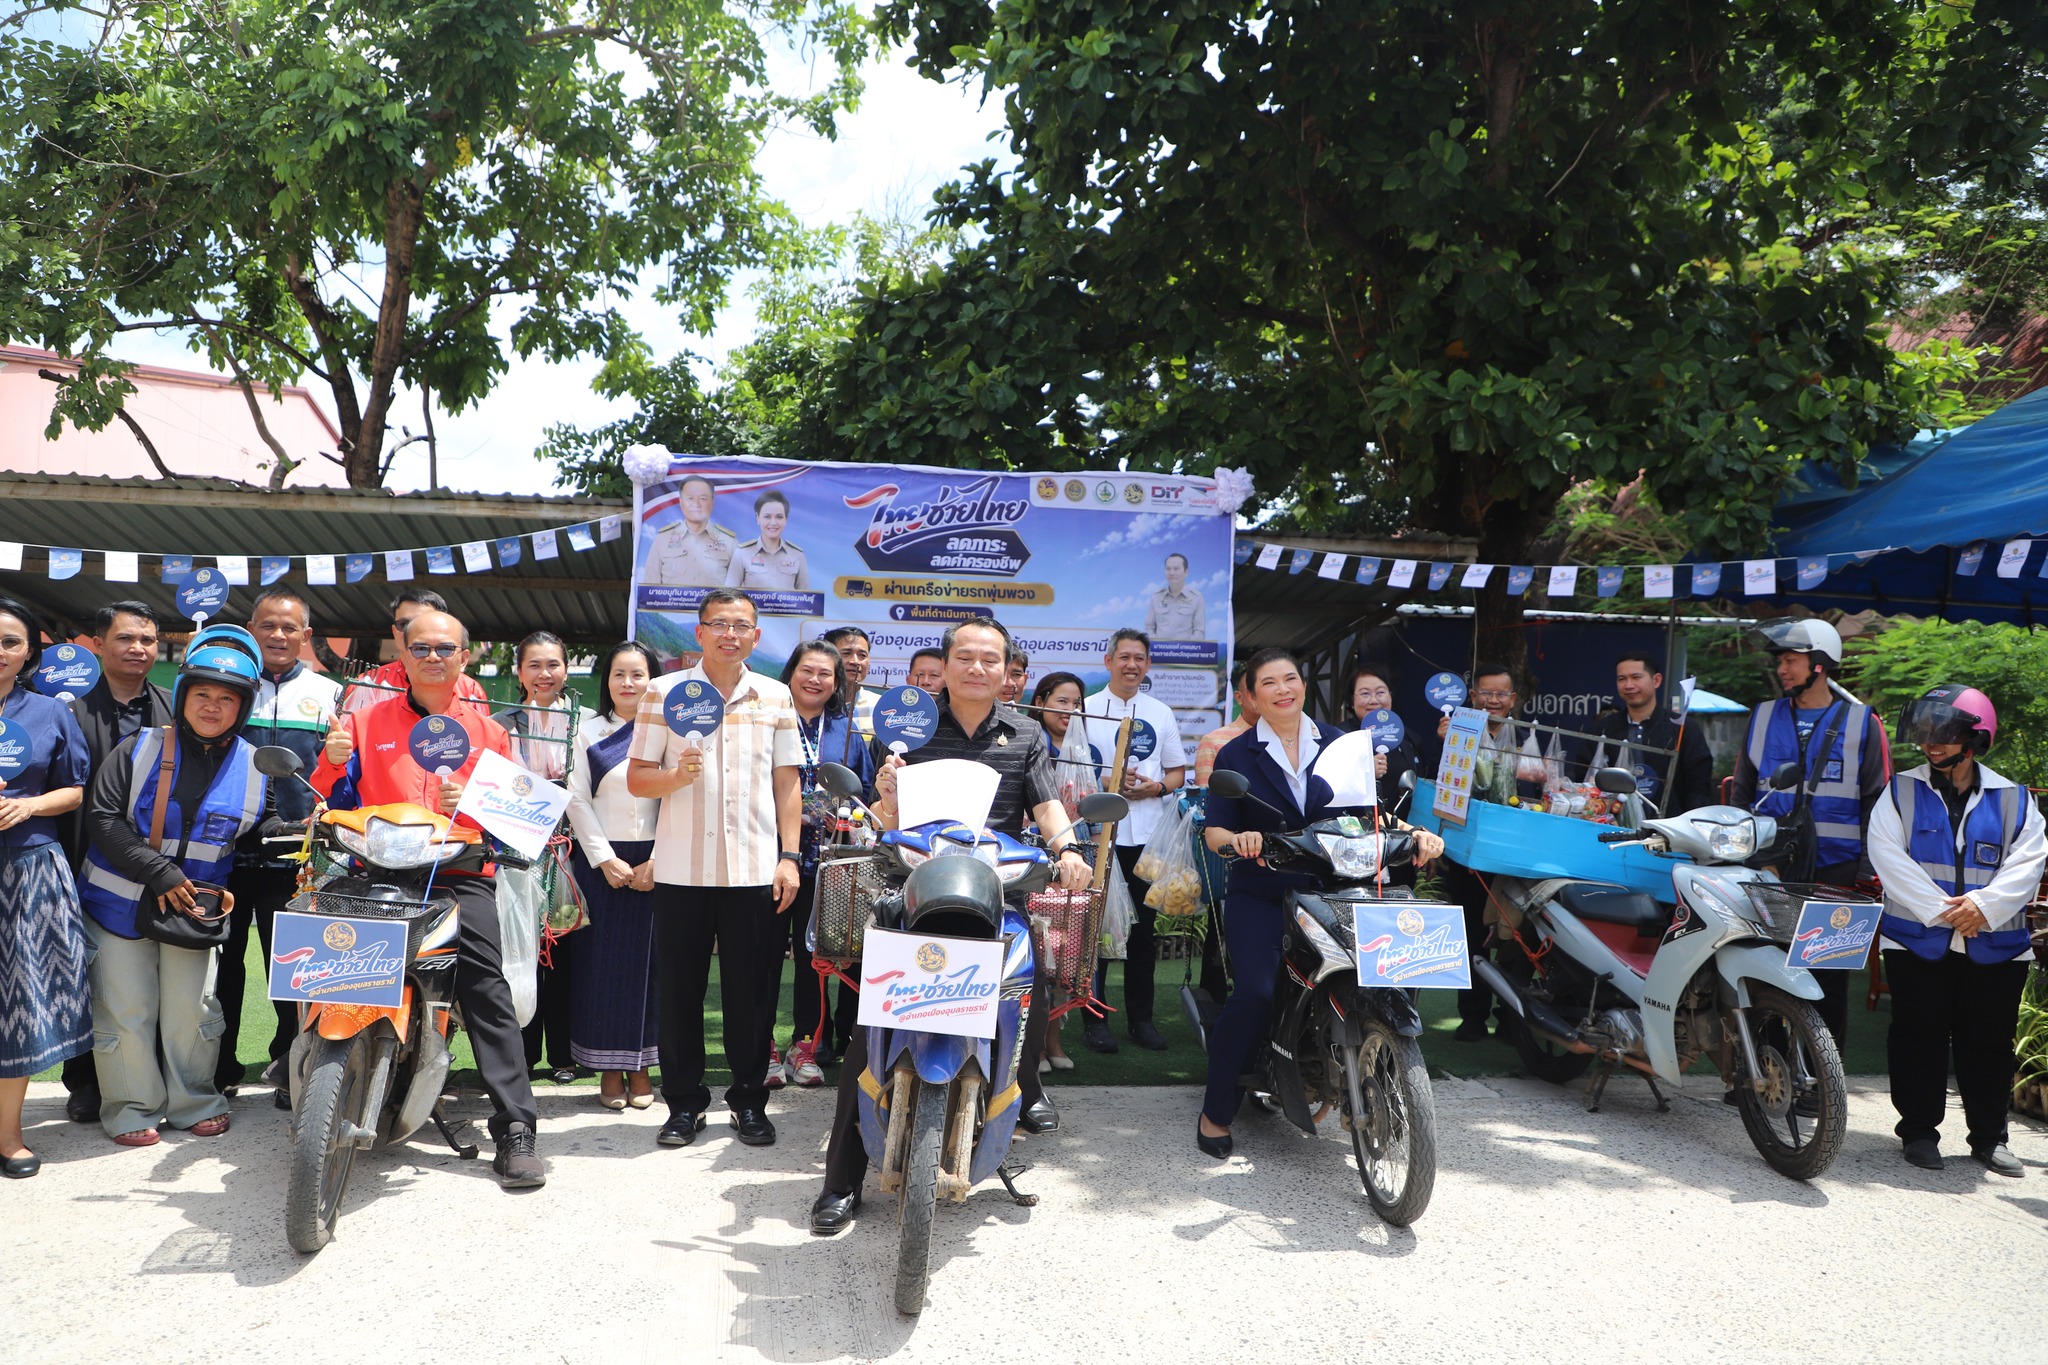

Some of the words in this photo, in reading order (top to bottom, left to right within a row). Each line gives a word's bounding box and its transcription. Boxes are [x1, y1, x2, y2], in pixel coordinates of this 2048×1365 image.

[844, 476, 1029, 549] ไทยช่วยไทย
[946, 537, 1008, 551] ลดภาระ
[930, 554, 1021, 570] ลดค่าครองชีพ
[884, 581, 1036, 602] ผ่านเครือข่ายรถพุ่มพวง
[910, 605, 977, 620] พื้นที่ดำเนินการ
[1357, 925, 1466, 976] ไทยช่วยไทย
[273, 941, 404, 989] ไทยช่วยไทย
[308, 976, 397, 998] @อำเภอเมืองอุบลราชธานี
[865, 964, 997, 1012] ไทยช่วยไทย
[898, 1003, 989, 1023] @อำเภอเมืองอุบลราชธานี
[1643, 996, 1671, 1012] YAMAHA
[1271, 1040, 1293, 1060] YAMAHA
